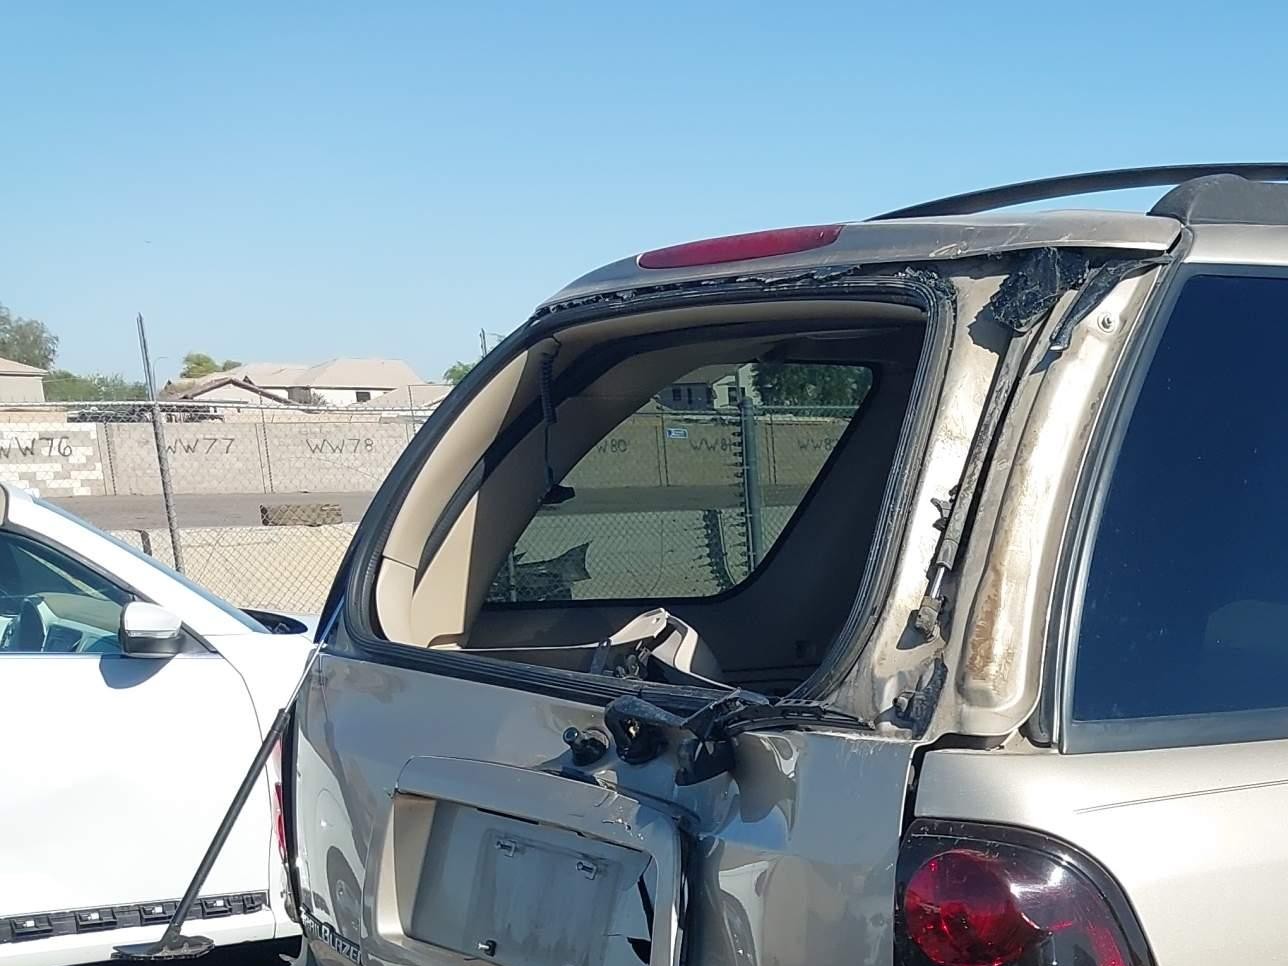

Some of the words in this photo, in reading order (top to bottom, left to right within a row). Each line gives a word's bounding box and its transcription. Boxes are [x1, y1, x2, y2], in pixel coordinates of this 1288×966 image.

[306, 437, 374, 454] WW78
[596, 438, 629, 453] W80
[799, 437, 840, 451] WW8
